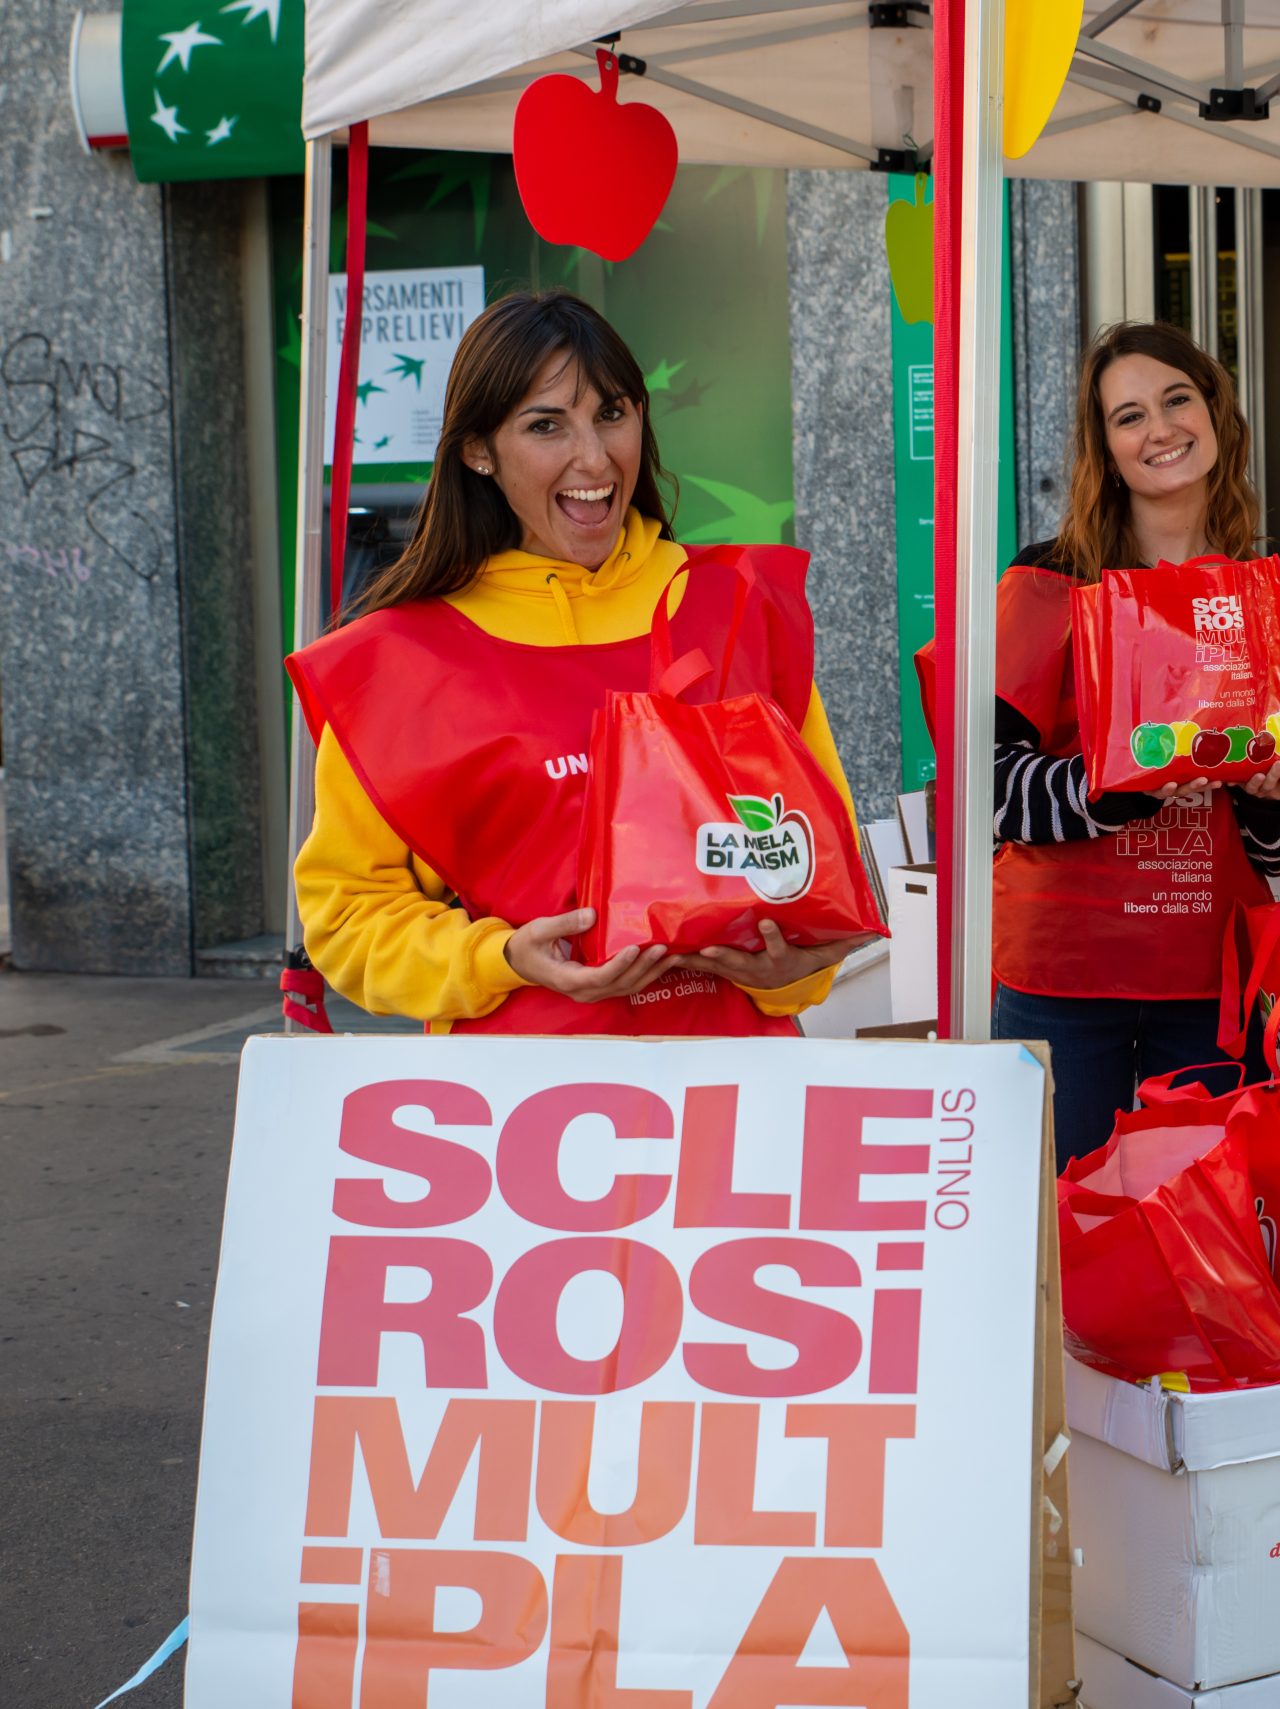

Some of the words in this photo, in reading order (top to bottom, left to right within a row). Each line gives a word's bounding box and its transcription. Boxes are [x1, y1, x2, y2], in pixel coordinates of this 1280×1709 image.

[335, 280, 464, 313] VRSAMENTI
[361, 312, 464, 344] PRELIEVI
[1192, 594, 1242, 614] SCL
[1194, 611, 1245, 631] ROS
[1195, 628, 1246, 646] MUL
[1203, 661, 1251, 672] associazion
[1198, 699, 1224, 708] libero
[1226, 698, 1245, 707] dalla
[1220, 690, 1230, 698] un
[545, 753, 589, 780] UN
[707, 832, 740, 849] LA
[744, 830, 795, 851] MELA
[706, 849, 733, 869] DI
[739, 847, 800, 870] AISM
[1137, 858, 1213, 870] associazione
[1171, 871, 1212, 883] italiana
[1152, 891, 1167, 901] un
[1171, 889, 1212, 901] mondo
[1124, 902, 1159, 913] libero
[1161, 902, 1189, 914] dalla
[1192, 902, 1212, 913] SM
[629, 988, 671, 1005] libero
[675, 980, 704, 997] dalla
[332, 1078, 934, 1232] SCLE
[934, 1087, 976, 1231] ONLUS
[303, 1395, 917, 1549] MULT
